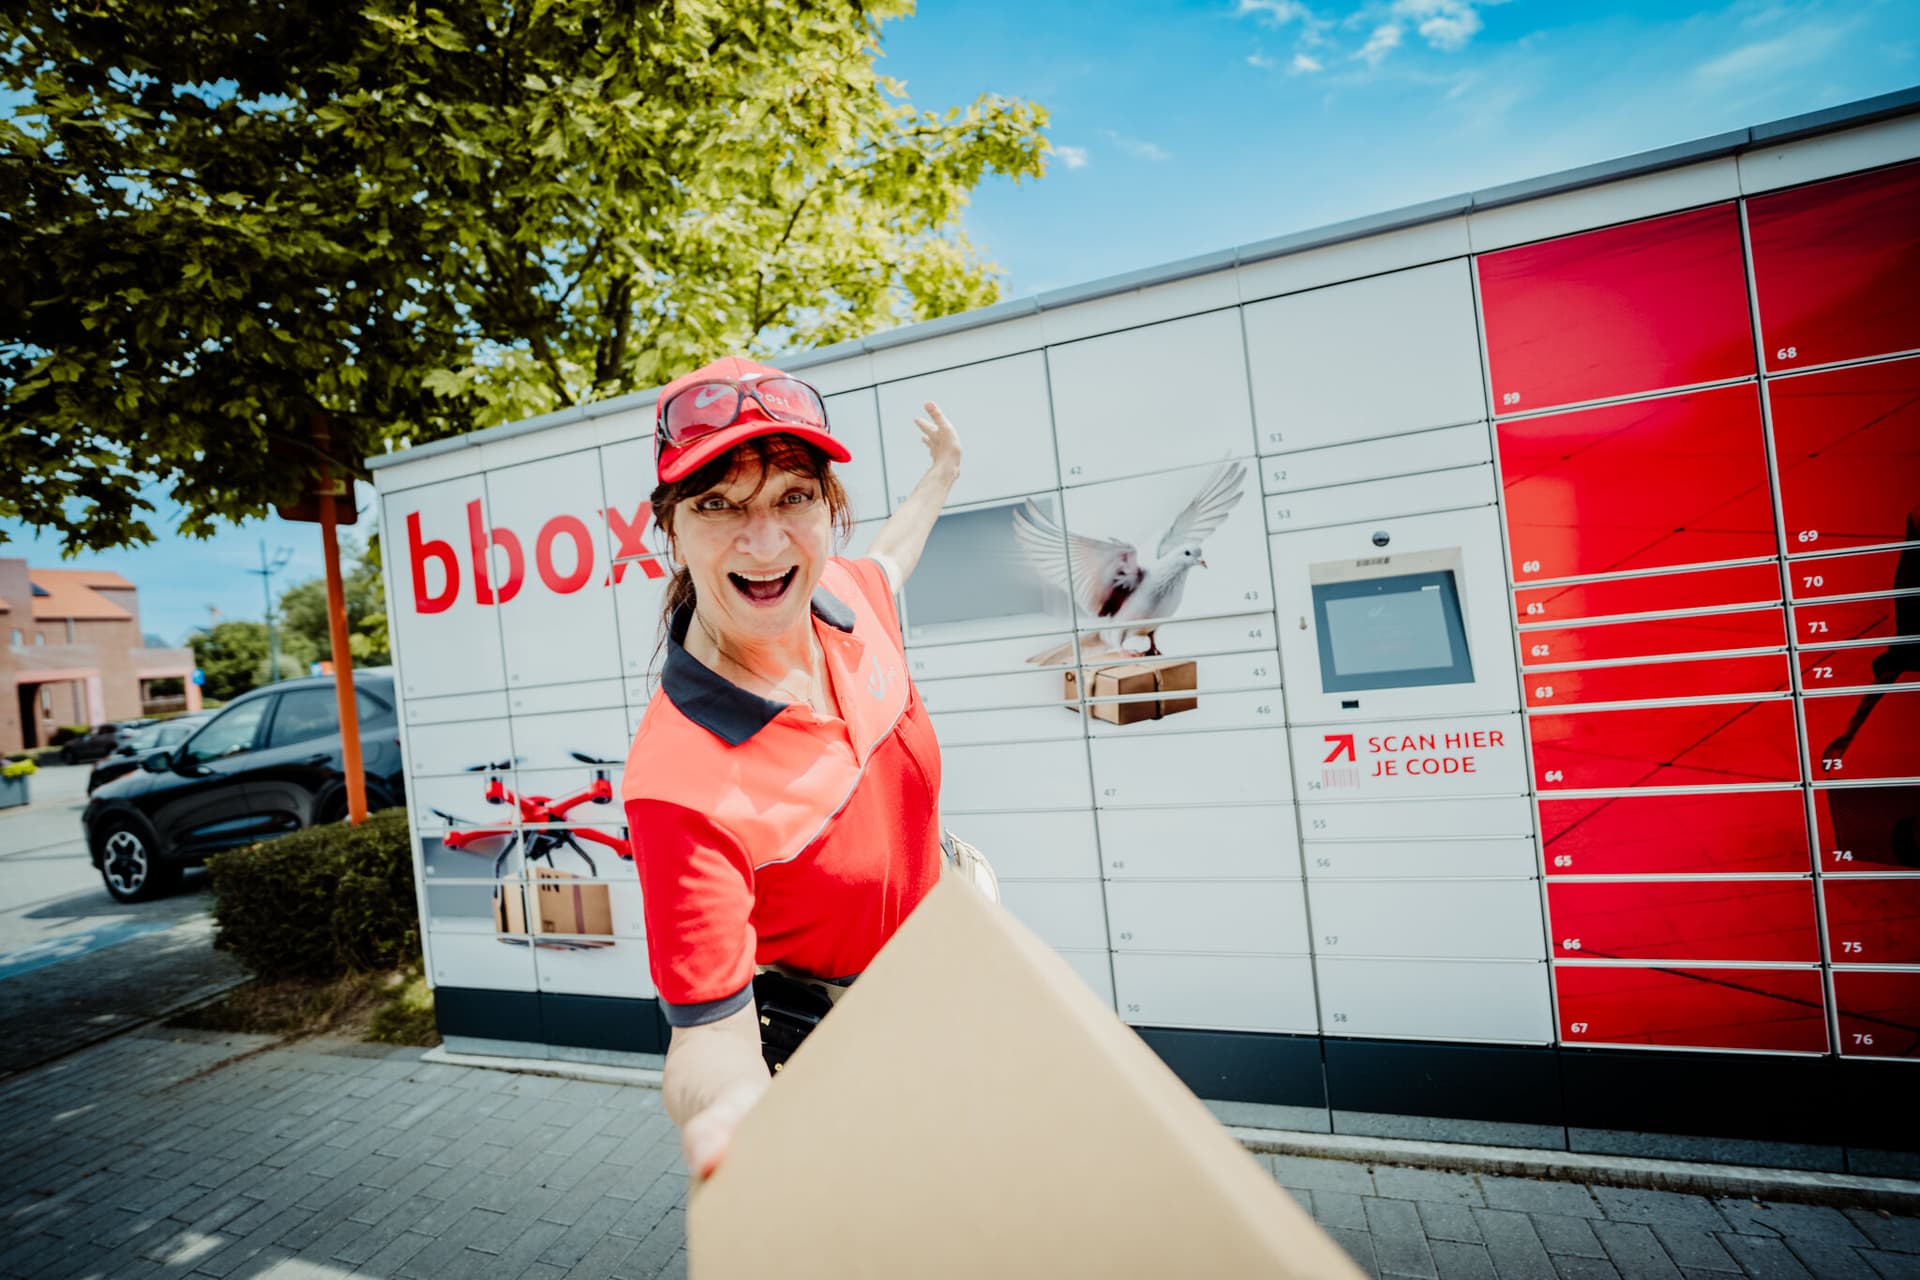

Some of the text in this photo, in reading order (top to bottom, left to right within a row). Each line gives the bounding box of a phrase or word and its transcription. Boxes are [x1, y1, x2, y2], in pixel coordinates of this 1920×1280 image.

[1776, 346, 1798, 360] 68
[1503, 391, 1521, 406] 59
[1273, 471, 1288, 481] 52
[1277, 509, 1291, 520] 53
[1798, 529, 1819, 543] 69
[406, 497, 667, 615] bbox
[1522, 560, 1541, 574] 60
[1802, 575, 1824, 588] 70
[1244, 591, 1259, 601] 43
[1526, 602, 1545, 615] 61
[1807, 621, 1829, 634] 71
[1531, 644, 1550, 657] 62
[1252, 667, 1267, 677] 45
[1812, 666, 1833, 679] 72
[1535, 685, 1554, 699] 63
[1255, 705, 1271, 715] 46
[1367, 730, 1505, 754] SCAN HIER
[1371, 756, 1477, 777] JE CODE
[1822, 758, 1843, 771] 73
[1544, 769, 1564, 783] 64
[1307, 781, 1321, 791] 54
[1312, 819, 1327, 829] 55
[1553, 855, 1573, 868] 65
[1832, 850, 1853, 862] 74
[1316, 858, 1331, 868] 56
[1562, 938, 1582, 950] 66
[1841, 941, 1863, 953] 75
[1570, 1022, 1588, 1034] 67
[1852, 1033, 1874, 1045] 76
